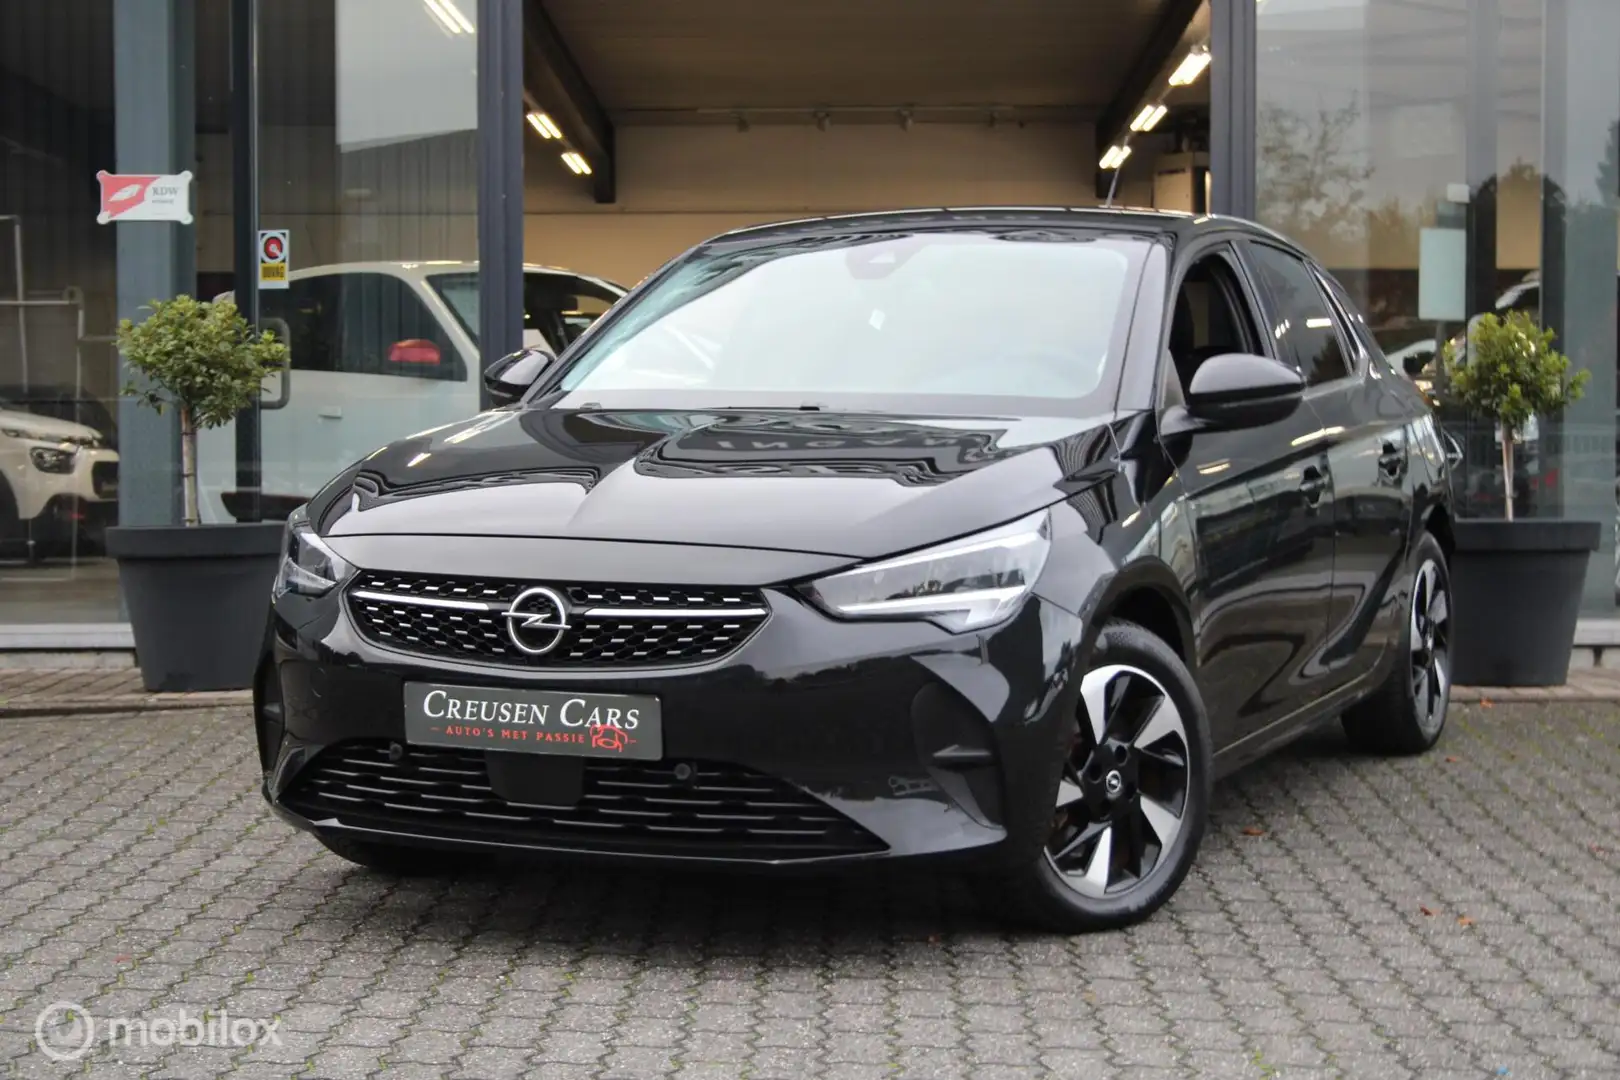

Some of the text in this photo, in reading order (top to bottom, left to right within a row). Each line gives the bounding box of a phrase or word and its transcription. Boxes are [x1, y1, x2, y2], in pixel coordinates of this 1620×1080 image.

[151, 186, 180, 196] RDW
[423, 690, 640, 729] CREUSEN CARS
[445, 725, 585, 743] AUTO'S MET PASSIE
